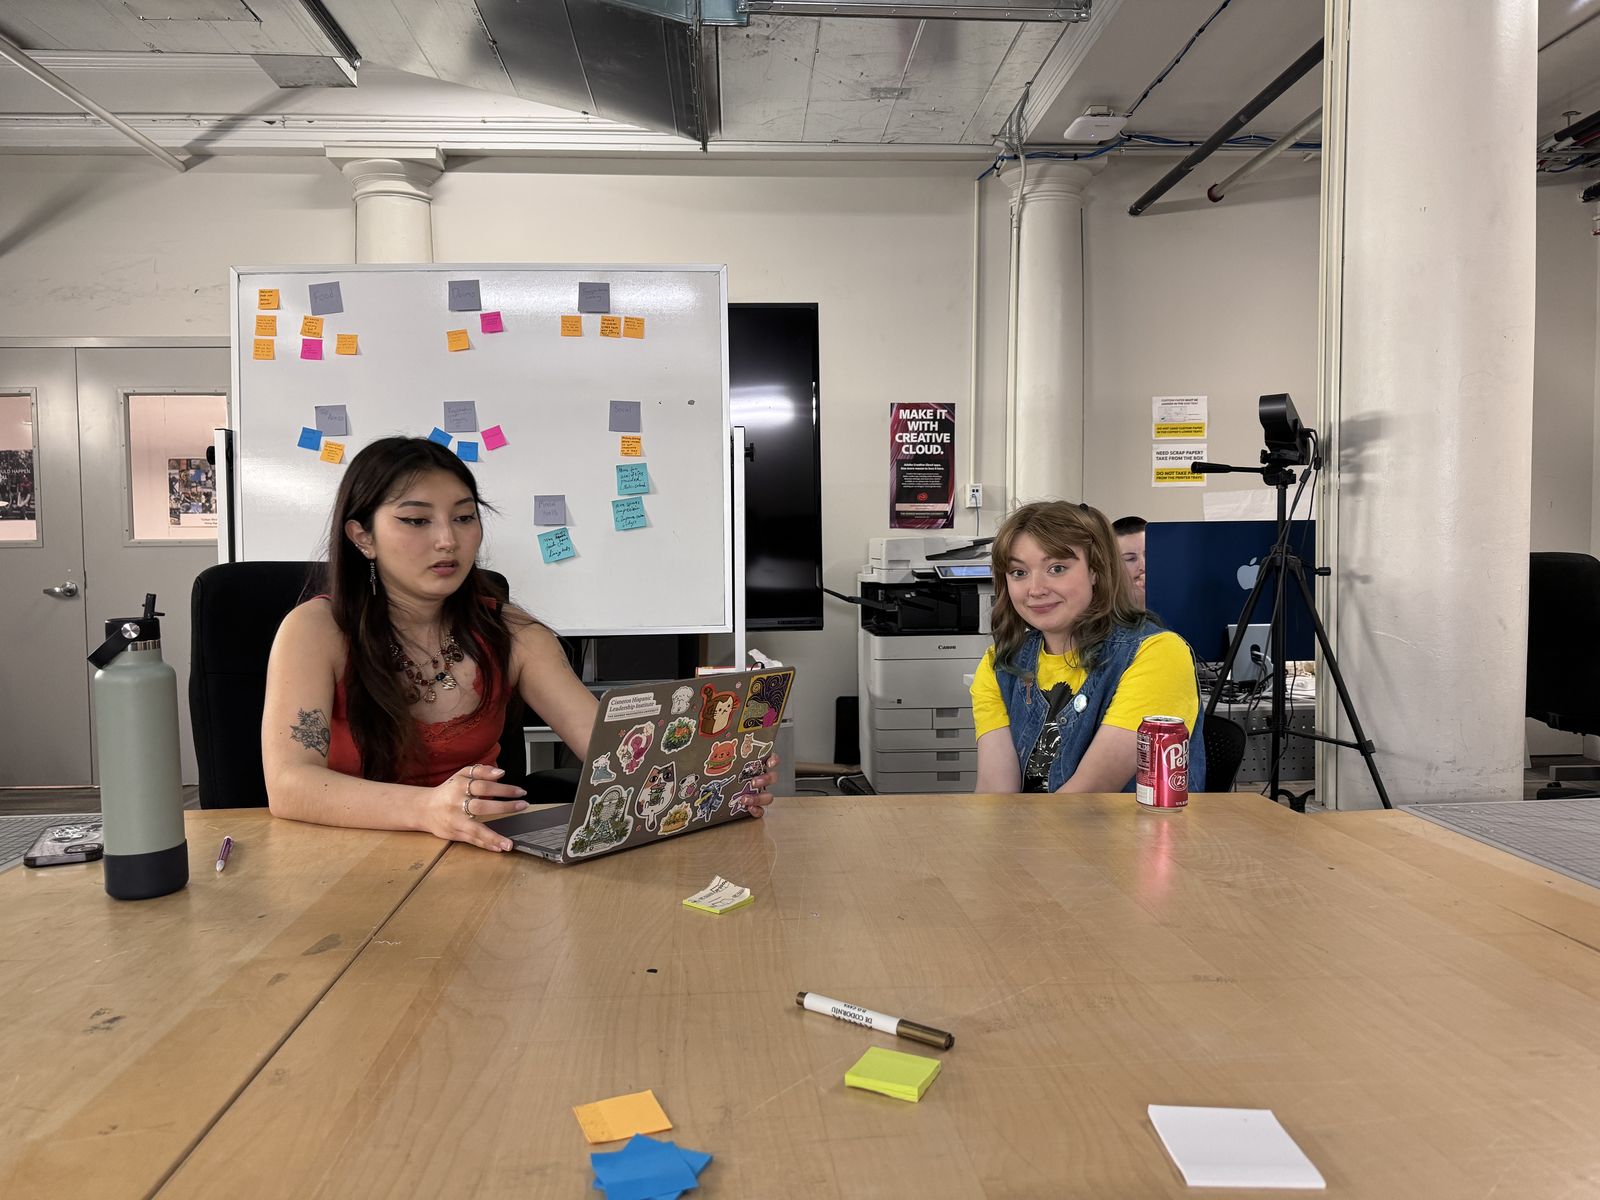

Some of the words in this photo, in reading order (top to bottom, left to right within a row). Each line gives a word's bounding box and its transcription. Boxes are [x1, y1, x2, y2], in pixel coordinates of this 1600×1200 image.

[899, 409, 934, 420] MAKE
[936, 409, 947, 420] IT
[907, 421, 938, 432] WITH
[895, 432, 951, 443] CREATIVE
[902, 444, 944, 455] CLOUD.
[1177, 776, 1185, 785] 23
